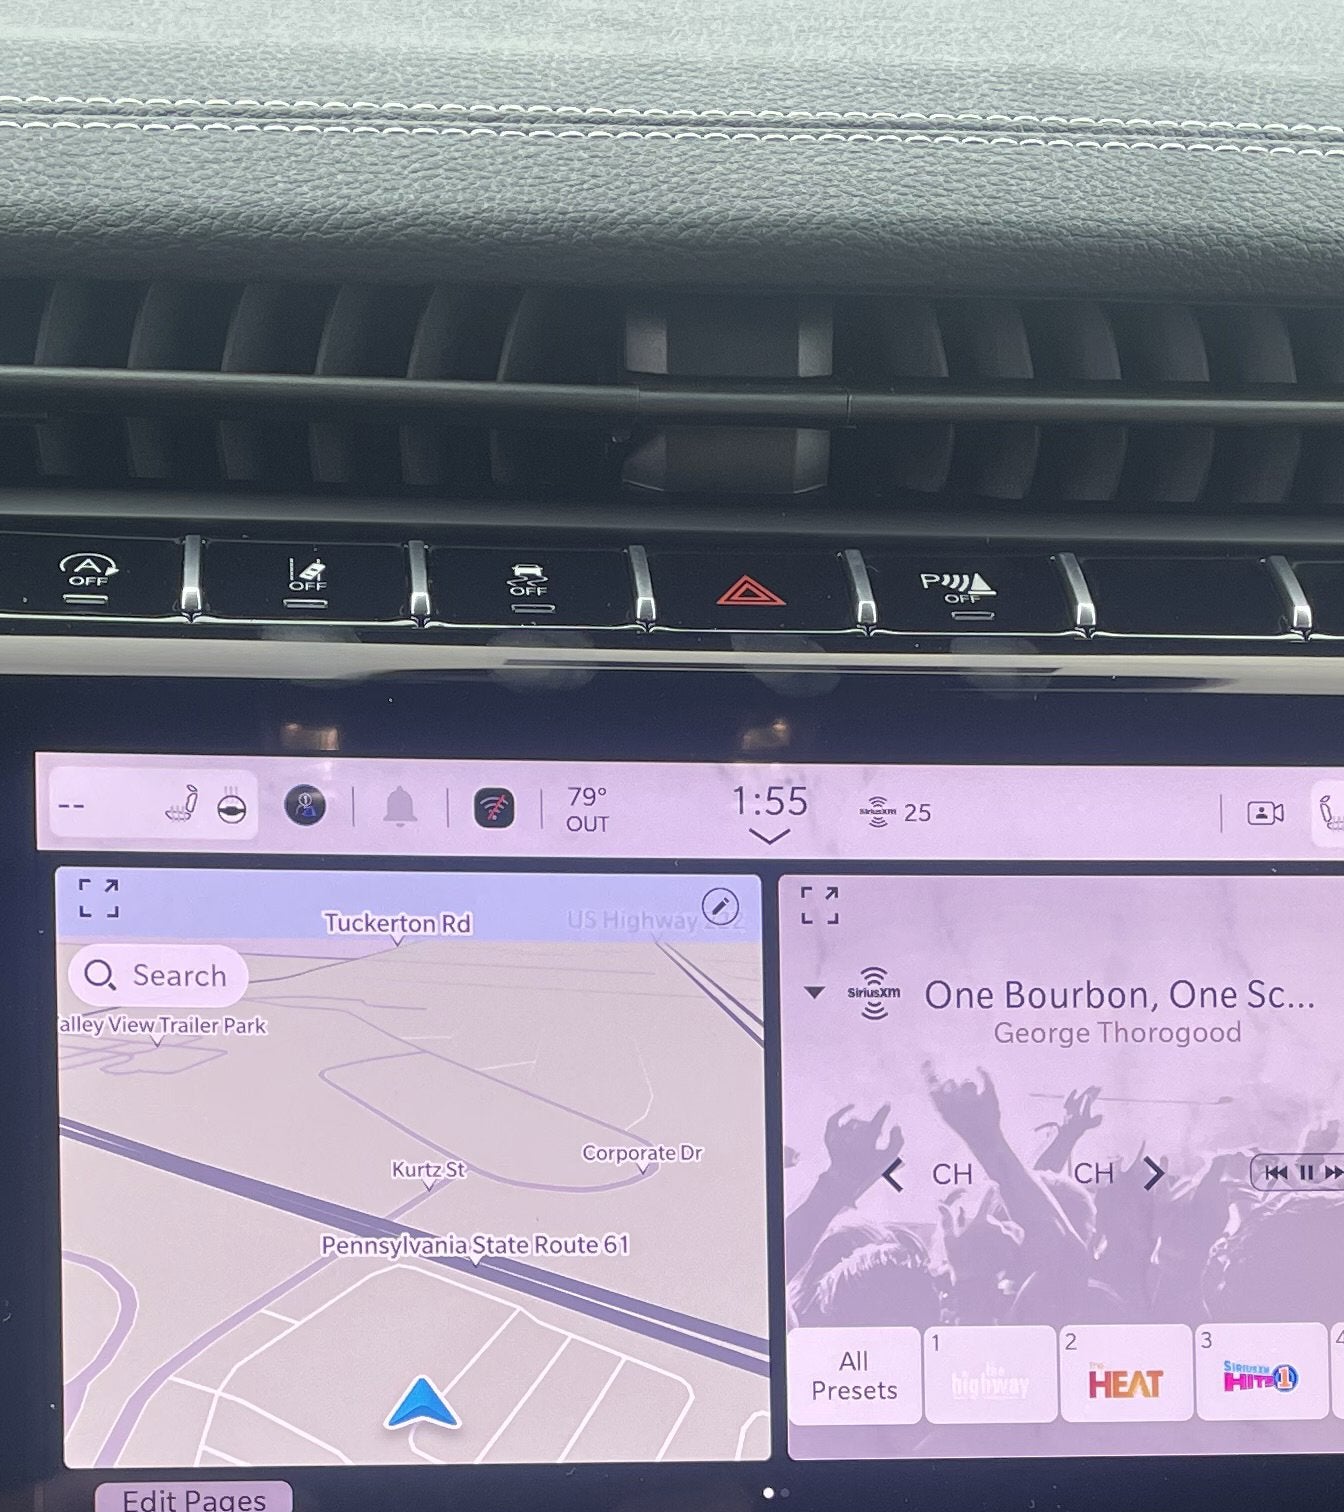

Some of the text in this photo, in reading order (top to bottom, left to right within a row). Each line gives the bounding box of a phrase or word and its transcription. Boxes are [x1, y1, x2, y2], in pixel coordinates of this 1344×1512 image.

[68, 576, 108, 586] OFF
[288, 581, 326, 591] OFF
[509, 586, 547, 596] OFF
[944, 594, 980, 604] OFF
[733, 785, 808, 816] 1:55
[904, 803, 931, 822] 25
[566, 815, 610, 833] OUT
[324, 912, 470, 933] Tuckerton Rd
[567, 910, 597, 929] US
[603, 911, 698, 934] Highway
[133, 963, 226, 987] Search
[925, 979, 994, 1009] One
[1006, 979, 1158, 1013] Bourbon,
[1169, 979, 1237, 1009] One
[58, 1016, 266, 1036] alley View Trailer Park
[994, 1020, 1241, 1049] George Thorogood
[583, 1144, 703, 1164] Corporate Dr
[393, 1161, 465, 1178] Kurtz St
[932, 1163, 972, 1185] CH
[1074, 1162, 1114, 1185] CH
[322, 1234, 629, 1259] Pennsylvania State Route 61
[931, 1334, 939, 1352] 1
[1065, 1332, 1077, 1351] 2
[1201, 1331, 1212, 1349] 3
[838, 1350, 868, 1372] All
[812, 1380, 898, 1401] Presets
[1089, 1370, 1165, 1398] HEAT
